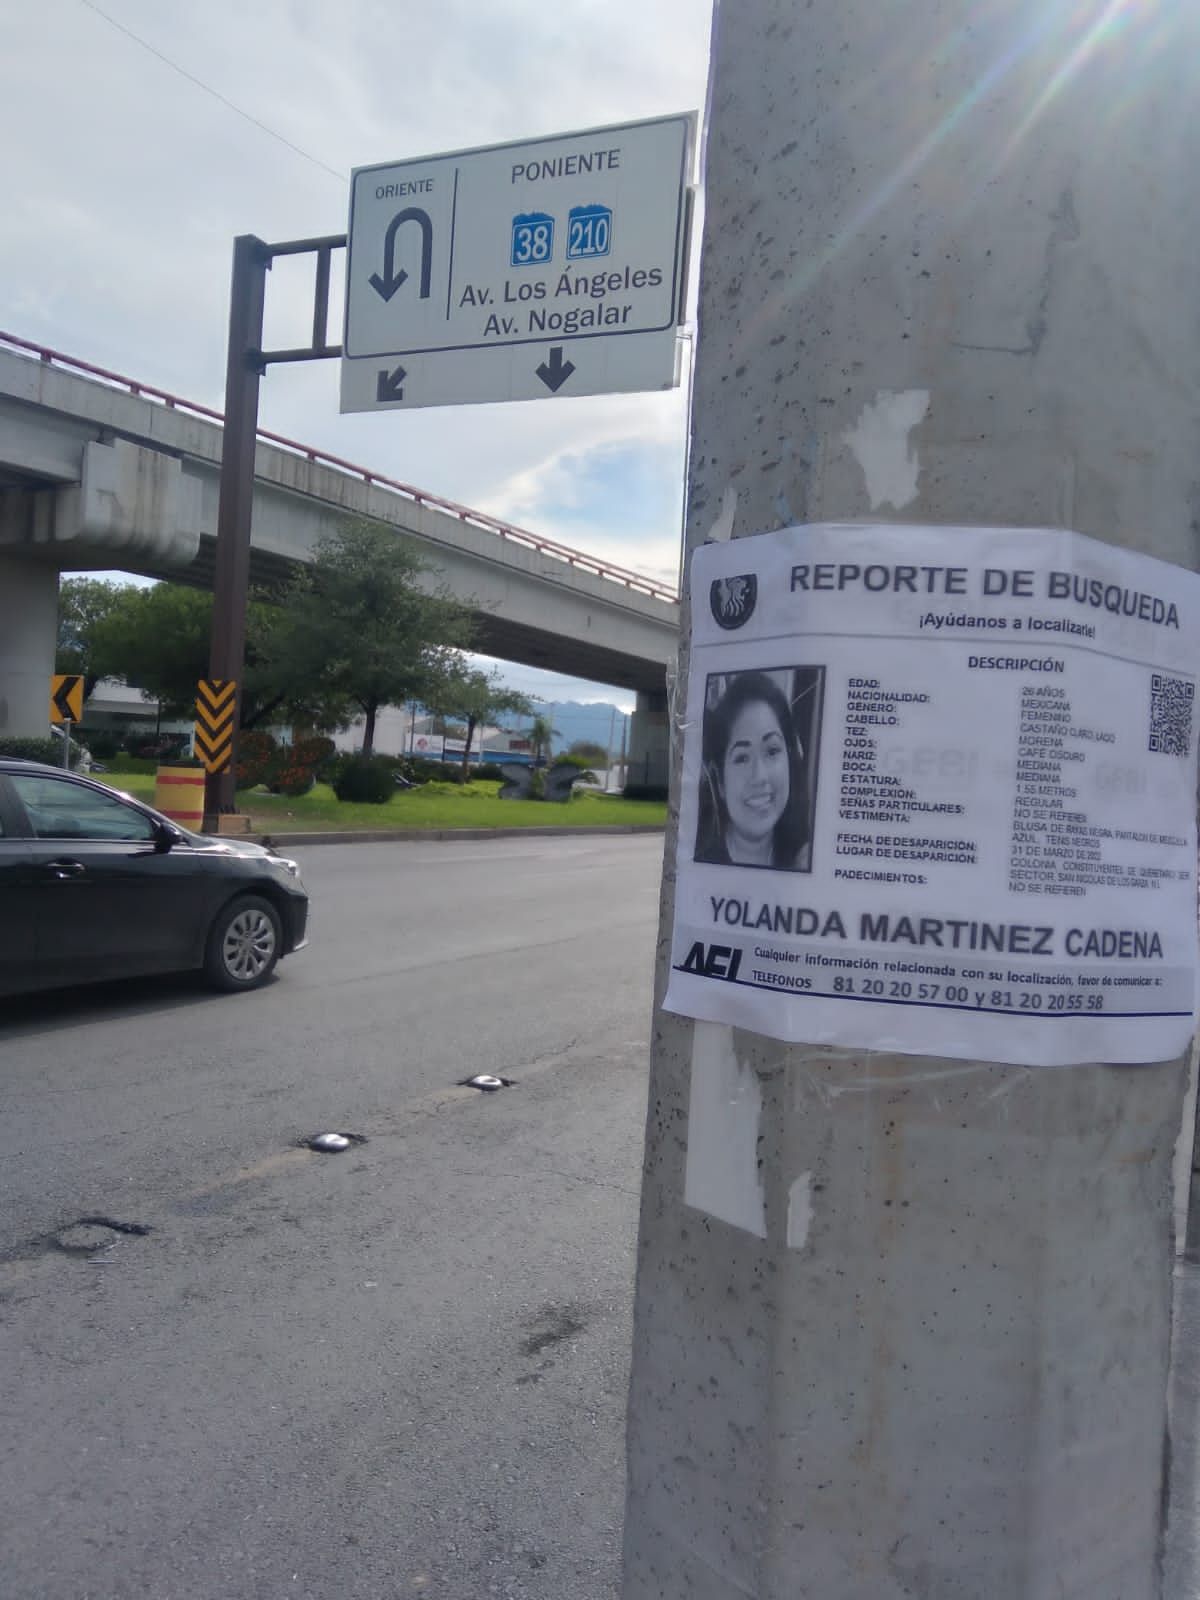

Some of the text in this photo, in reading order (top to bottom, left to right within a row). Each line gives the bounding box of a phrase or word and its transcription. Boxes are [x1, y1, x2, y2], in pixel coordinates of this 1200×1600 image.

[511, 149, 621, 184] PONIENTE
[375, 178, 434, 199] ORIENTE
[516, 221, 609, 262] 38 210
[459, 265, 662, 308] Av. Los Ángeles
[484, 304, 633, 336] Av. Nogalar
[790, 564, 1180, 629] REPORTE DE BUSQUEDA
[920, 612, 1007, 629] ¡Ayúdanos
[1013, 618, 1022, 629] a
[968, 656, 1065, 673] DESCRIPCIÓN
[849, 678, 880, 688] EDAD:
[848, 691, 930, 703] NACIONALIDAD:
[1035, 686, 1065, 698] AÑOS
[847, 702, 897, 713] GENERO:
[846, 714, 900, 726] CABELLO:
[1021, 711, 1071, 723] FEMENINO
[844, 738, 877, 748] OJOS:
[843, 751, 877, 760] NARIZ:
[842, 762, 876, 772] BOCA:
[841, 774, 901, 786] ESTATURA:
[879, 800, 965, 814] PARTICULARES:
[839, 810, 910, 823] VESTIMENTA:
[837, 833, 873, 844] FECHA
[876, 836, 891, 846] DE
[836, 846, 873, 857] LUGAR
[876, 848, 891, 858] DE
[835, 869, 927, 884] PADECIMIENTOS:
[710, 896, 1164, 958] YOLANDA MARTINEZ CADENA
[754, 947, 800, 964] Cualquier
[805, 952, 879, 971] información
[884, 962, 956, 977] relacionada
[962, 968, 984, 980] con
[989, 971, 1002, 981] su
[1007, 970, 1073, 986] localización,
[1078, 975, 1100, 986] favor
[1102, 975, 1112, 986] de
[752, 970, 812, 989] TELEFONOS
[833, 975, 855, 992] 81
[862, 979, 884, 995] 20
[890, 981, 912, 998] 20
[918, 983, 940, 1000] 57
[945, 986, 968, 1002] 00
[975, 992, 985, 1008] y
[991, 990, 1012, 1007] 81
[1019, 993, 1042, 1009] 20
[1047, 995, 1066, 1010] 20
[1067, 995, 1083, 1009] 55
